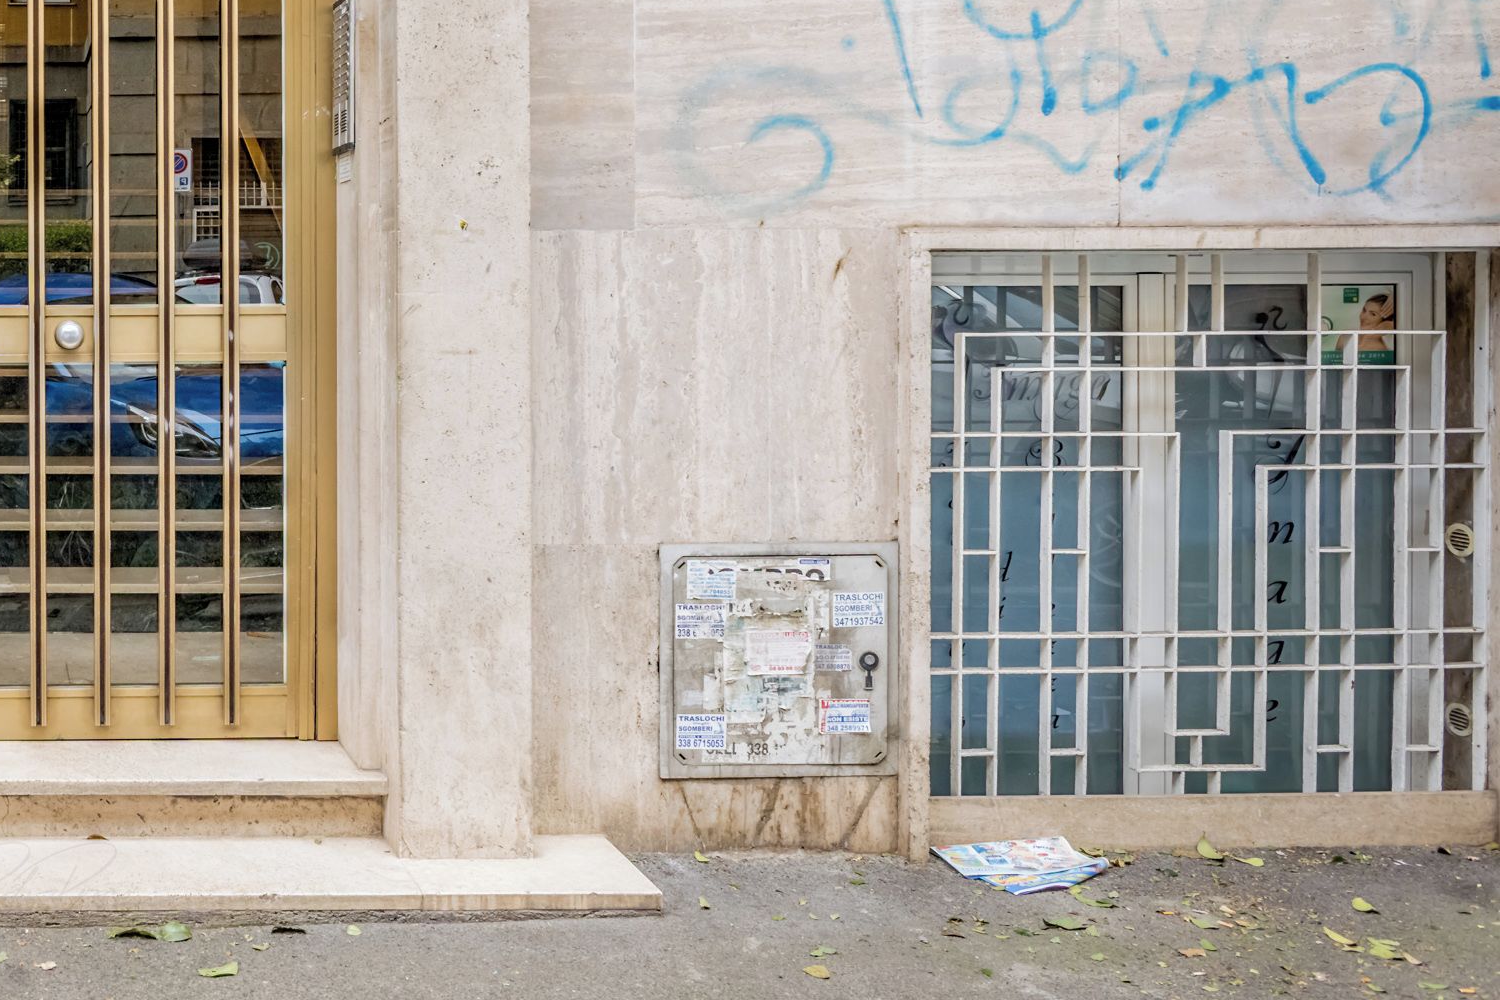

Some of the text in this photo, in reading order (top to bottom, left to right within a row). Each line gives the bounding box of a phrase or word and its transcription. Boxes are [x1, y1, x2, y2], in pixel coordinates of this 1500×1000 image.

[835, 617, 884, 626] 3471937542
[678, 739, 725, 748] 338 6715053
